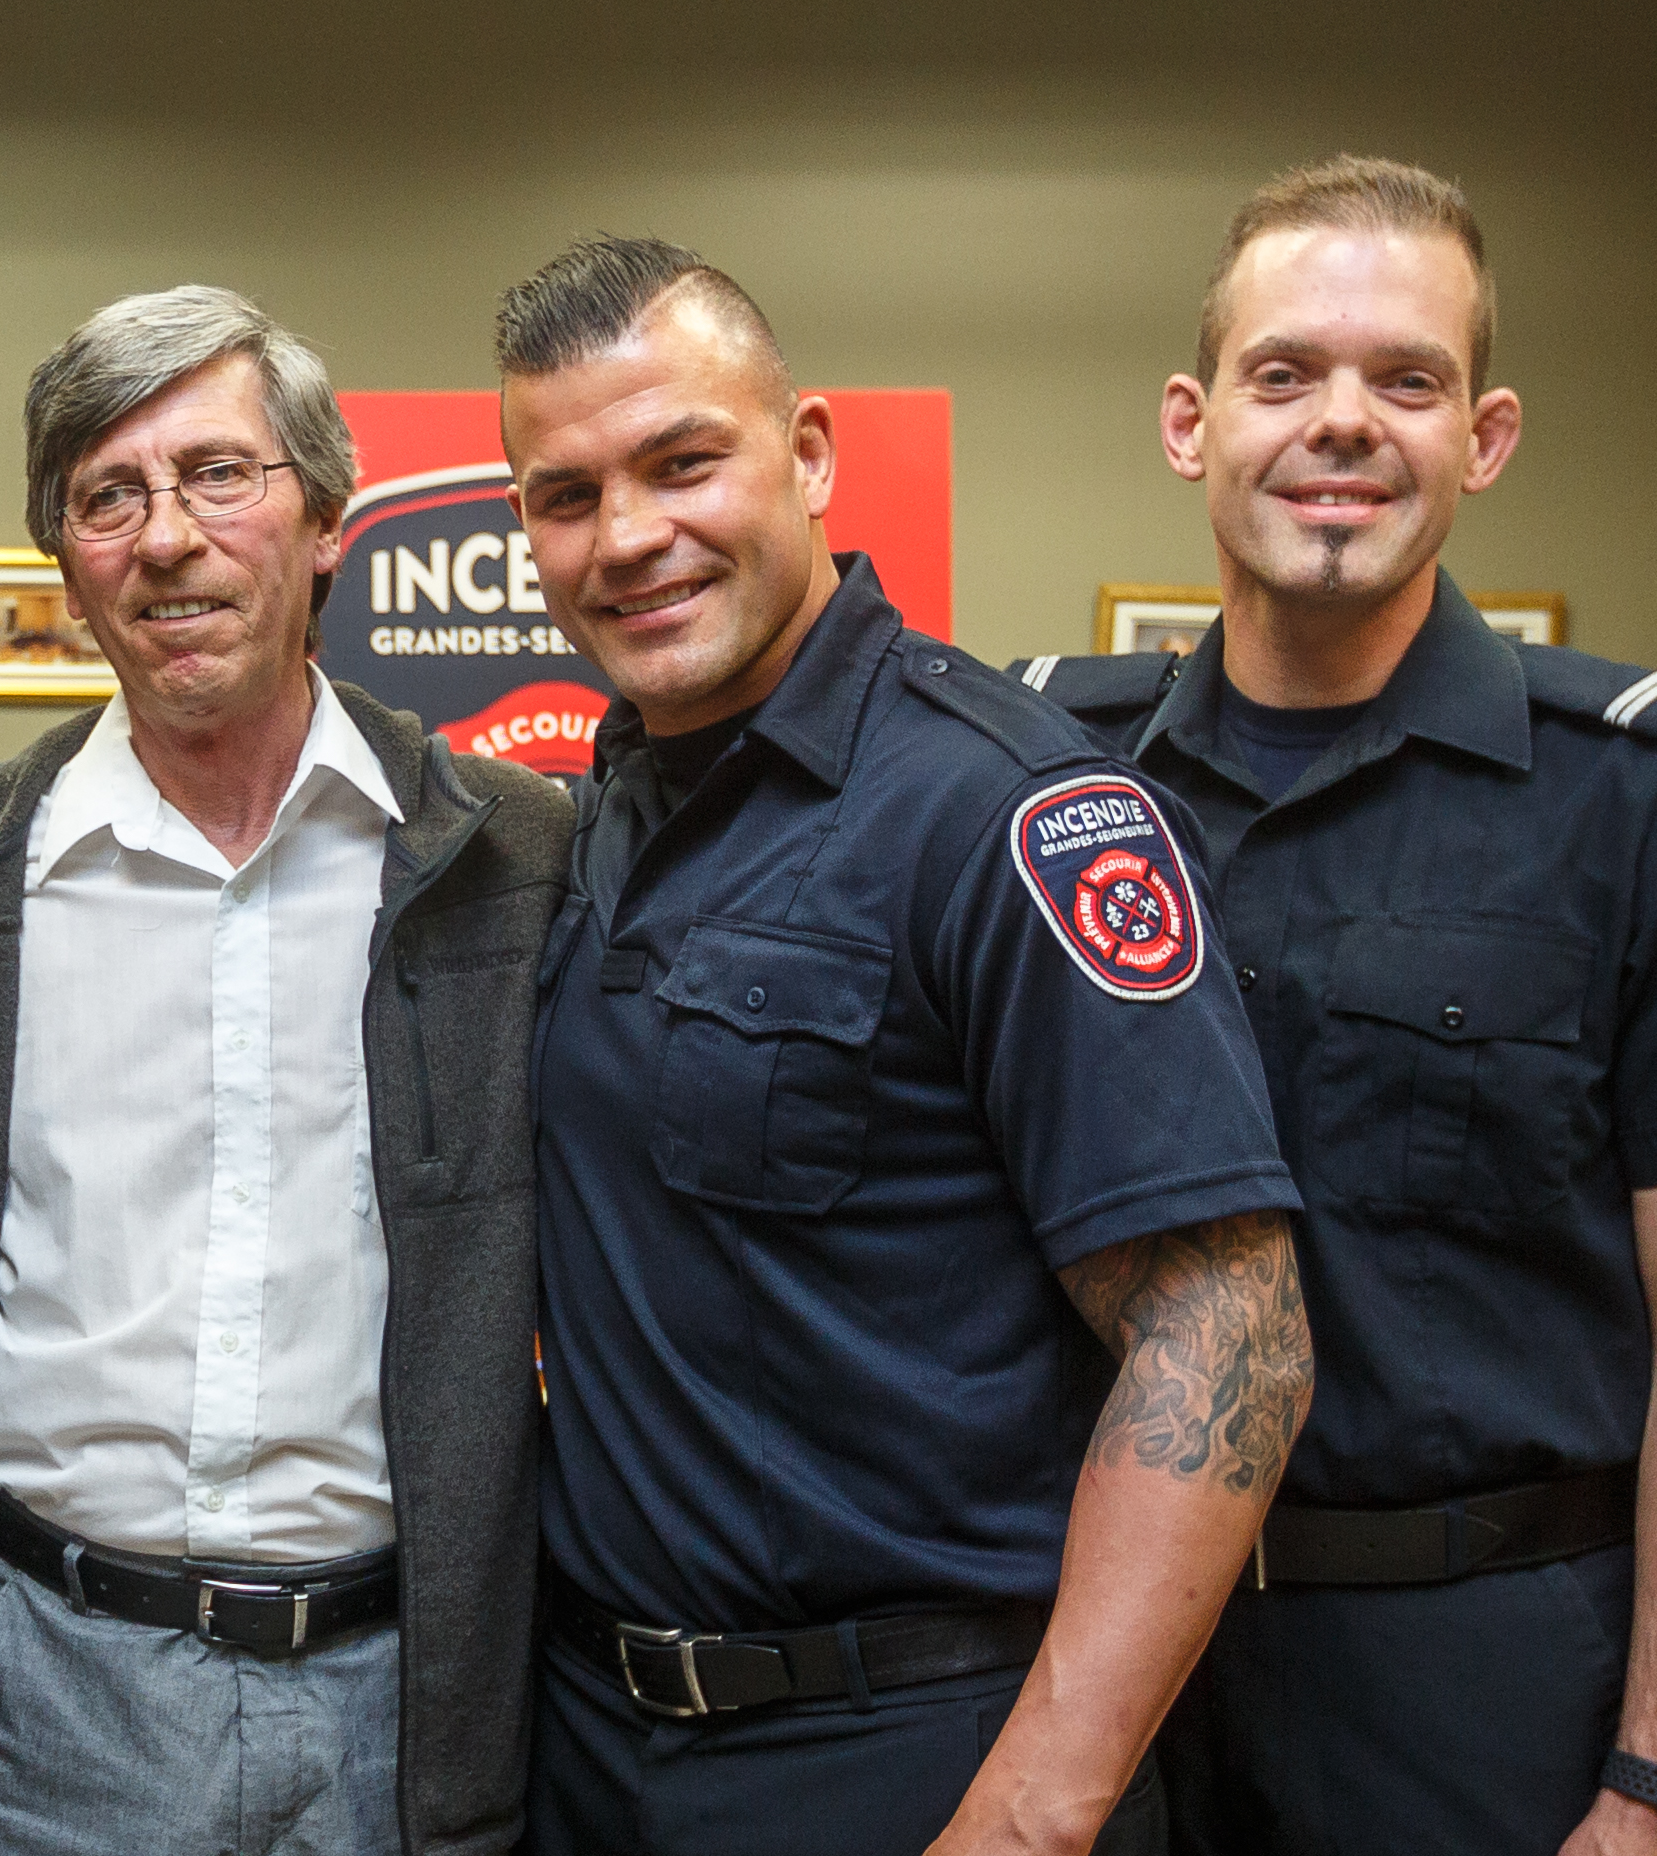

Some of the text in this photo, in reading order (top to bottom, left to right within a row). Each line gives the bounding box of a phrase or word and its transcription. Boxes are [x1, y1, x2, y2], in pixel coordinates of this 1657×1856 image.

[370, 531, 547, 614] INCE
[1037, 798, 1145, 841] INCENDIE
[1089, 858, 1143, 883] SECOURIR
[1132, 925, 1150, 941] 23
